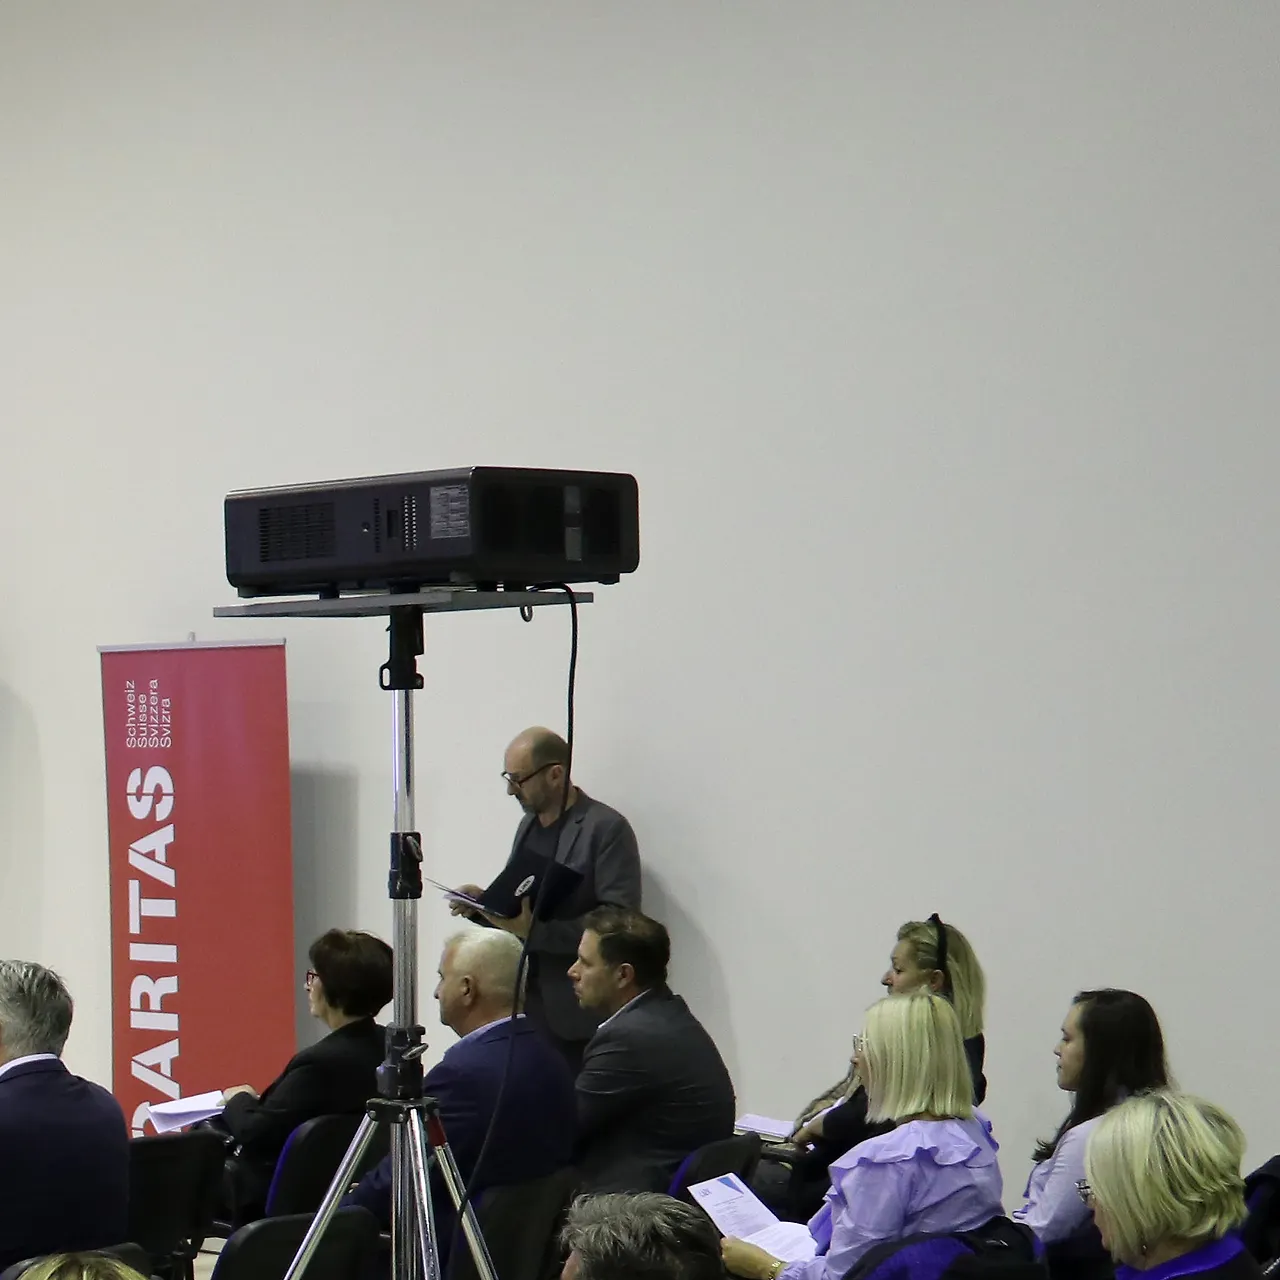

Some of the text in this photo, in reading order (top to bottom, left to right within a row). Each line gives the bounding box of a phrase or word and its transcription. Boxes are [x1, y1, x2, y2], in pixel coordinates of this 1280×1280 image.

[124, 680, 136, 748] Schweiz
[137, 694, 147, 748] Suisse
[148, 679, 159, 748] Svizzera
[160, 698, 172, 748] Svizra
